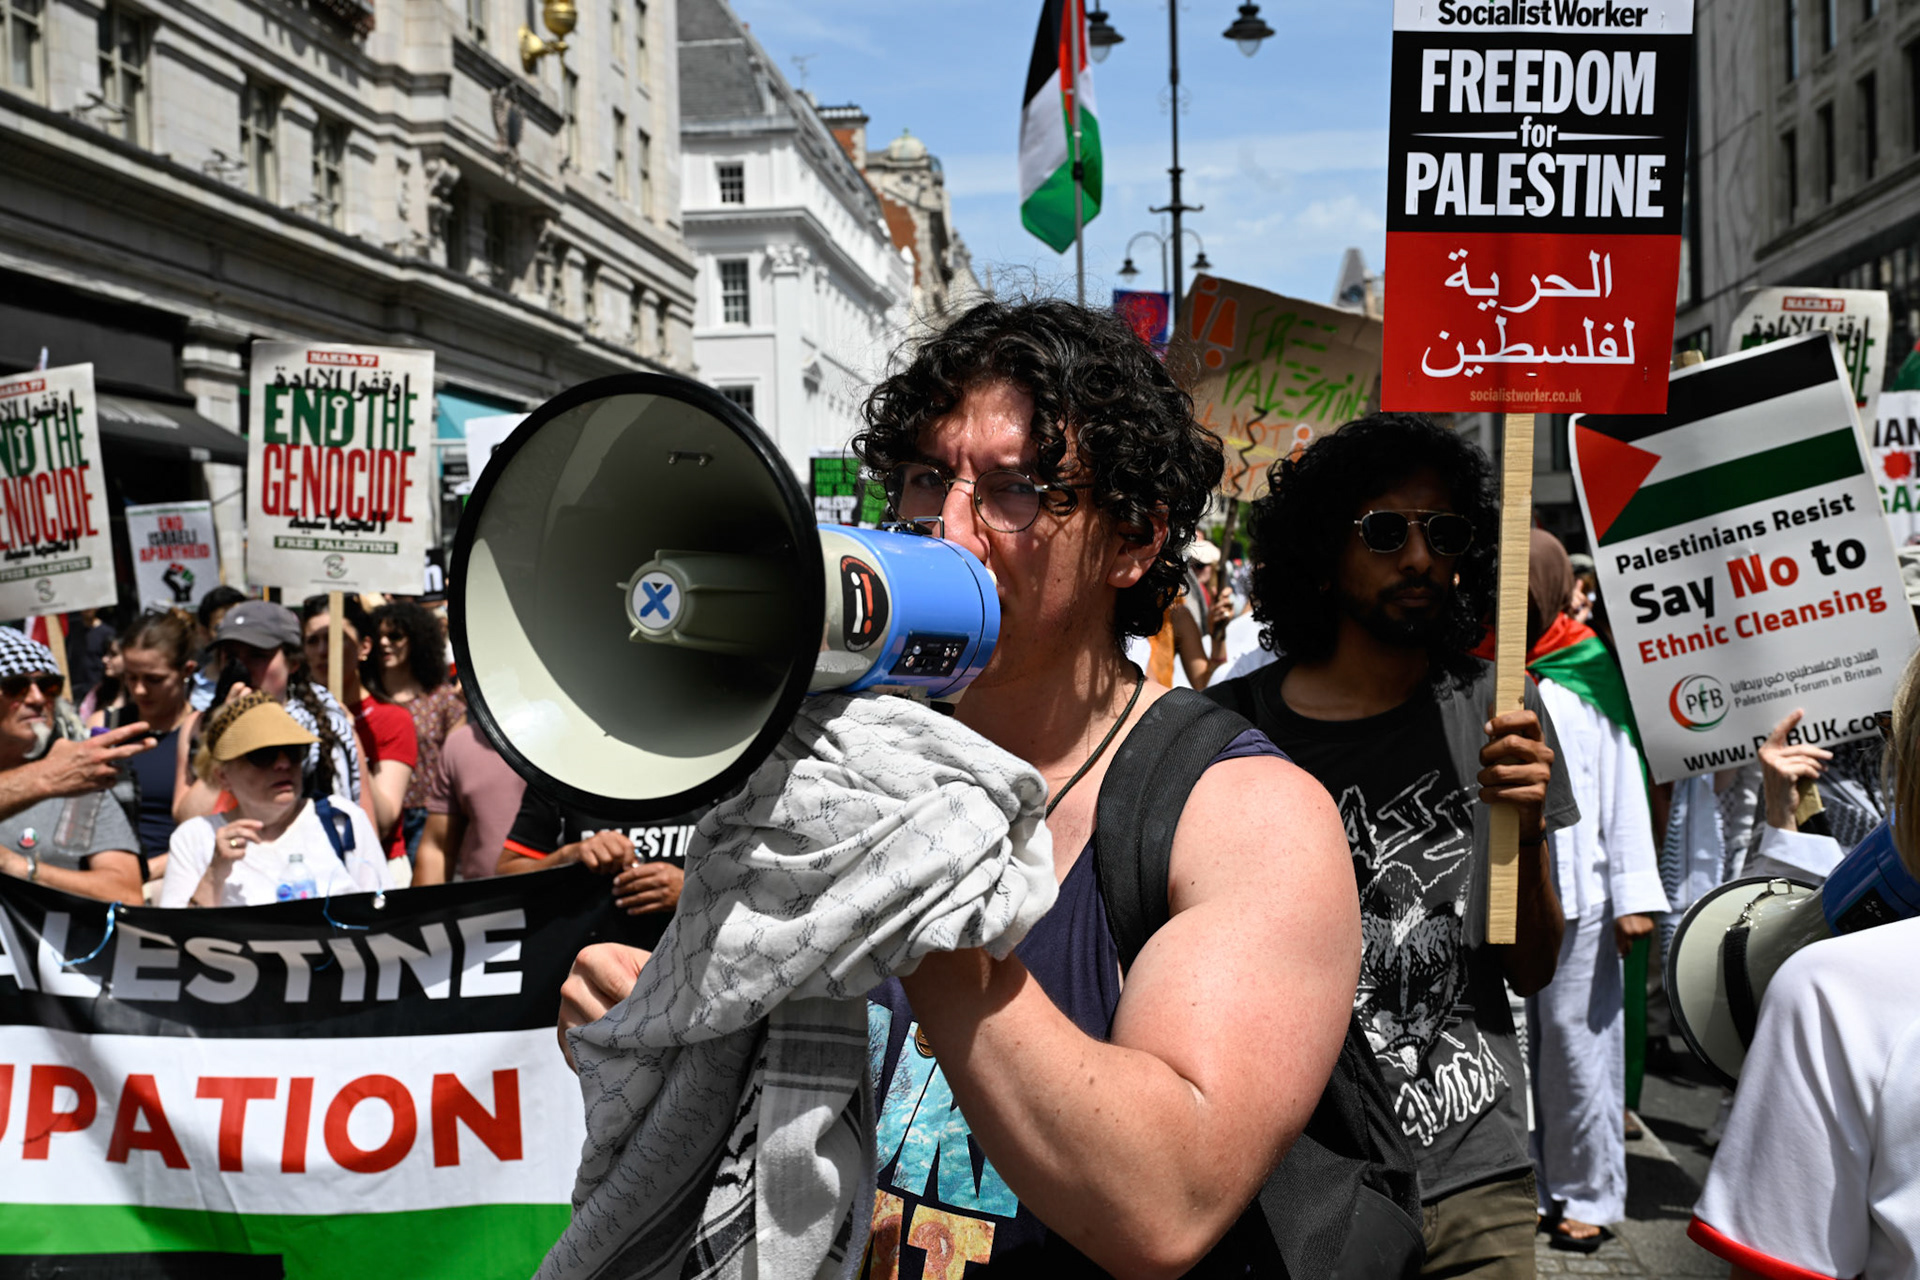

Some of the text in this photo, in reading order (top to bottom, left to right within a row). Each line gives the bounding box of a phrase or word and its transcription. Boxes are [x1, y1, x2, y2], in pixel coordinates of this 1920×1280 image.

[1420, 48, 1657, 116] FREEDOM
[1519, 116, 1557, 148] for
[1405, 152, 1666, 218] PALESTINE
[1444, 248, 1612, 313] الحرية
[310, 352, 377, 366] NAKBA 77
[1421, 315, 1635, 378] لفلسطين
[264, 384, 418, 453] END THE
[1470, 388, 1582, 403] socialistworker.co.uk
[0, 417, 37, 478] ND
[40, 406, 89, 472] THE
[262, 443, 416, 523] GENOCIDE
[139, 543, 210, 562] APARTHEID
[147, 529, 197, 547] ISRAELI
[158, 515, 184, 531] END
[277, 537, 315, 549] FREE
[1615, 493, 1856, 575] Palestinians Resist
[1629, 538, 1866, 625] Say No to
[1638, 586, 1888, 664] Ethnic Cleansing
[1686, 688, 1724, 715] PFB
[1734, 665, 1883, 708] Palestinian Forum in Britain
